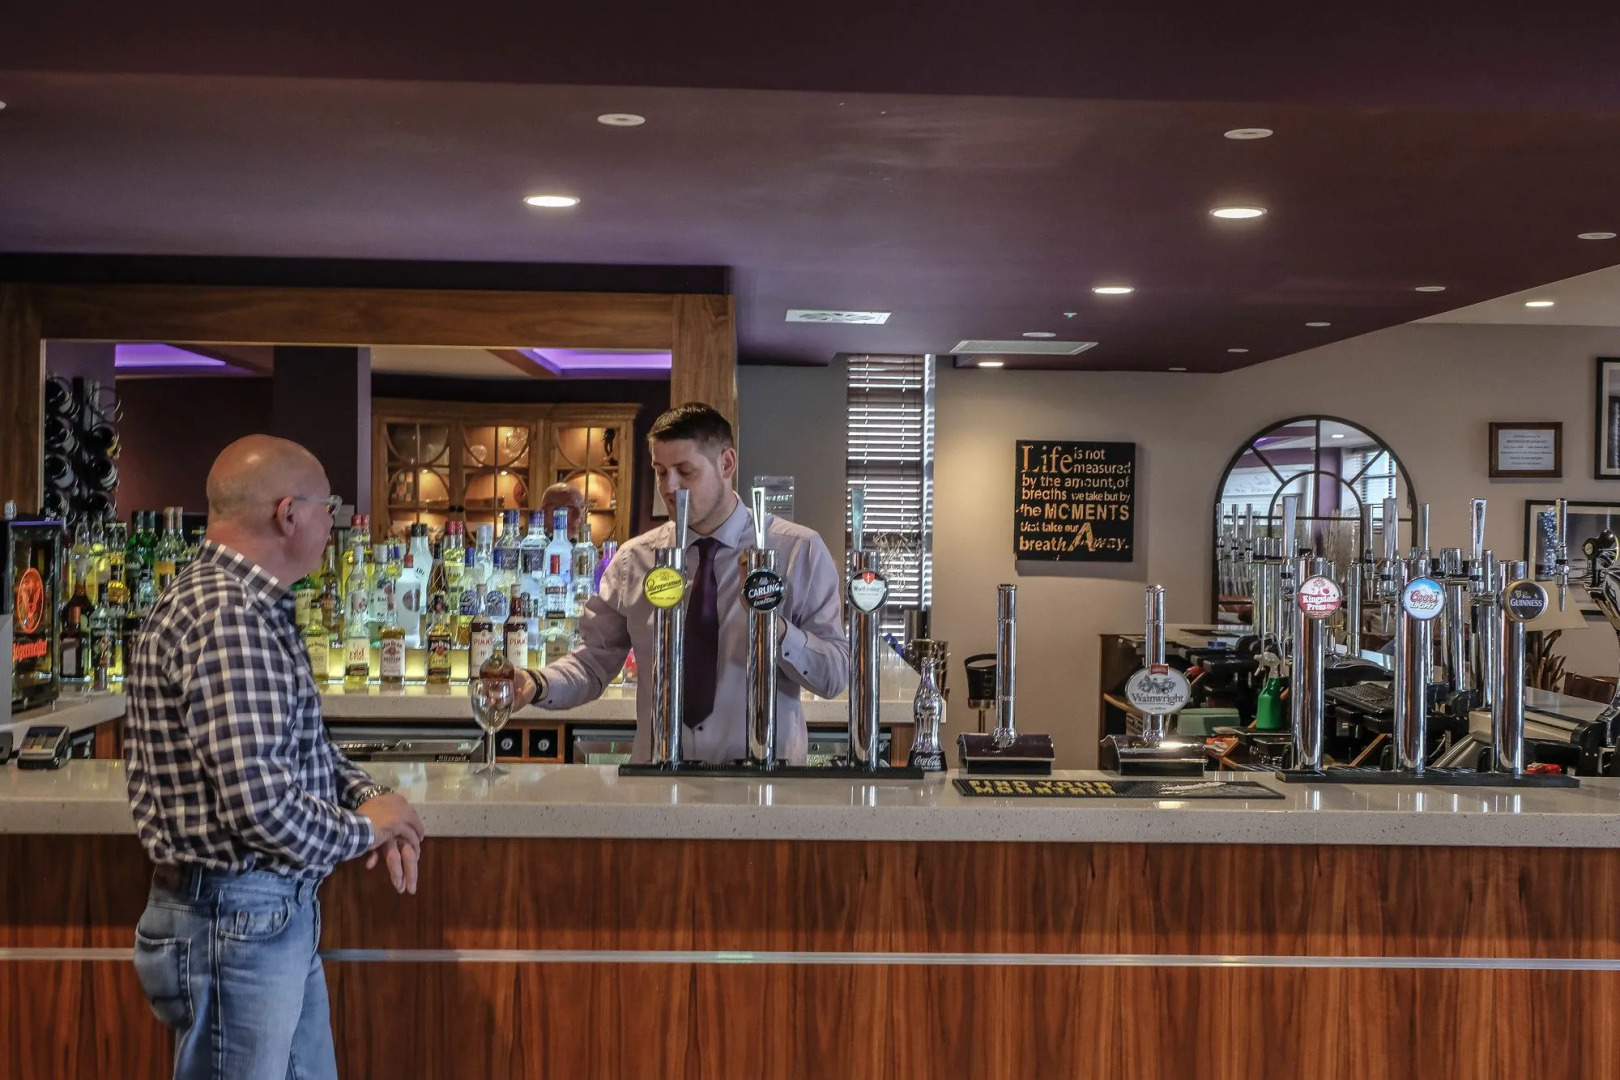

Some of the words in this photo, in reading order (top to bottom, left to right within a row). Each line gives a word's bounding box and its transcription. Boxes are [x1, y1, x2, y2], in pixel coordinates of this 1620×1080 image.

[1021, 445, 1073, 474] Life
[1074, 447, 1083, 460] is
[1086, 449, 1106, 461] not
[1073, 462, 1131, 474] measured
[1022, 474, 1038, 488] by
[1041, 475, 1061, 487] the
[1117, 475, 1130, 488] of
[1021, 487, 1067, 500] breaths
[1071, 493, 1084, 501] we
[1085, 491, 1103, 502] take
[1104, 491, 1118, 502] but
[1119, 492, 1131, 503] by
[1018, 504, 1042, 517] the
[1020, 521, 1040, 532] that
[1042, 521, 1064, 533] take
[1065, 524, 1080, 533] our
[1019, 535, 1067, 551] breath
[748, 583, 780, 599] CARLING
[1410, 589, 1439, 603] Coors
[1410, 602, 1438, 610] LIGHT
[1510, 599, 1543, 607] GUINNESS
[1131, 693, 1184, 706] Wainwright
